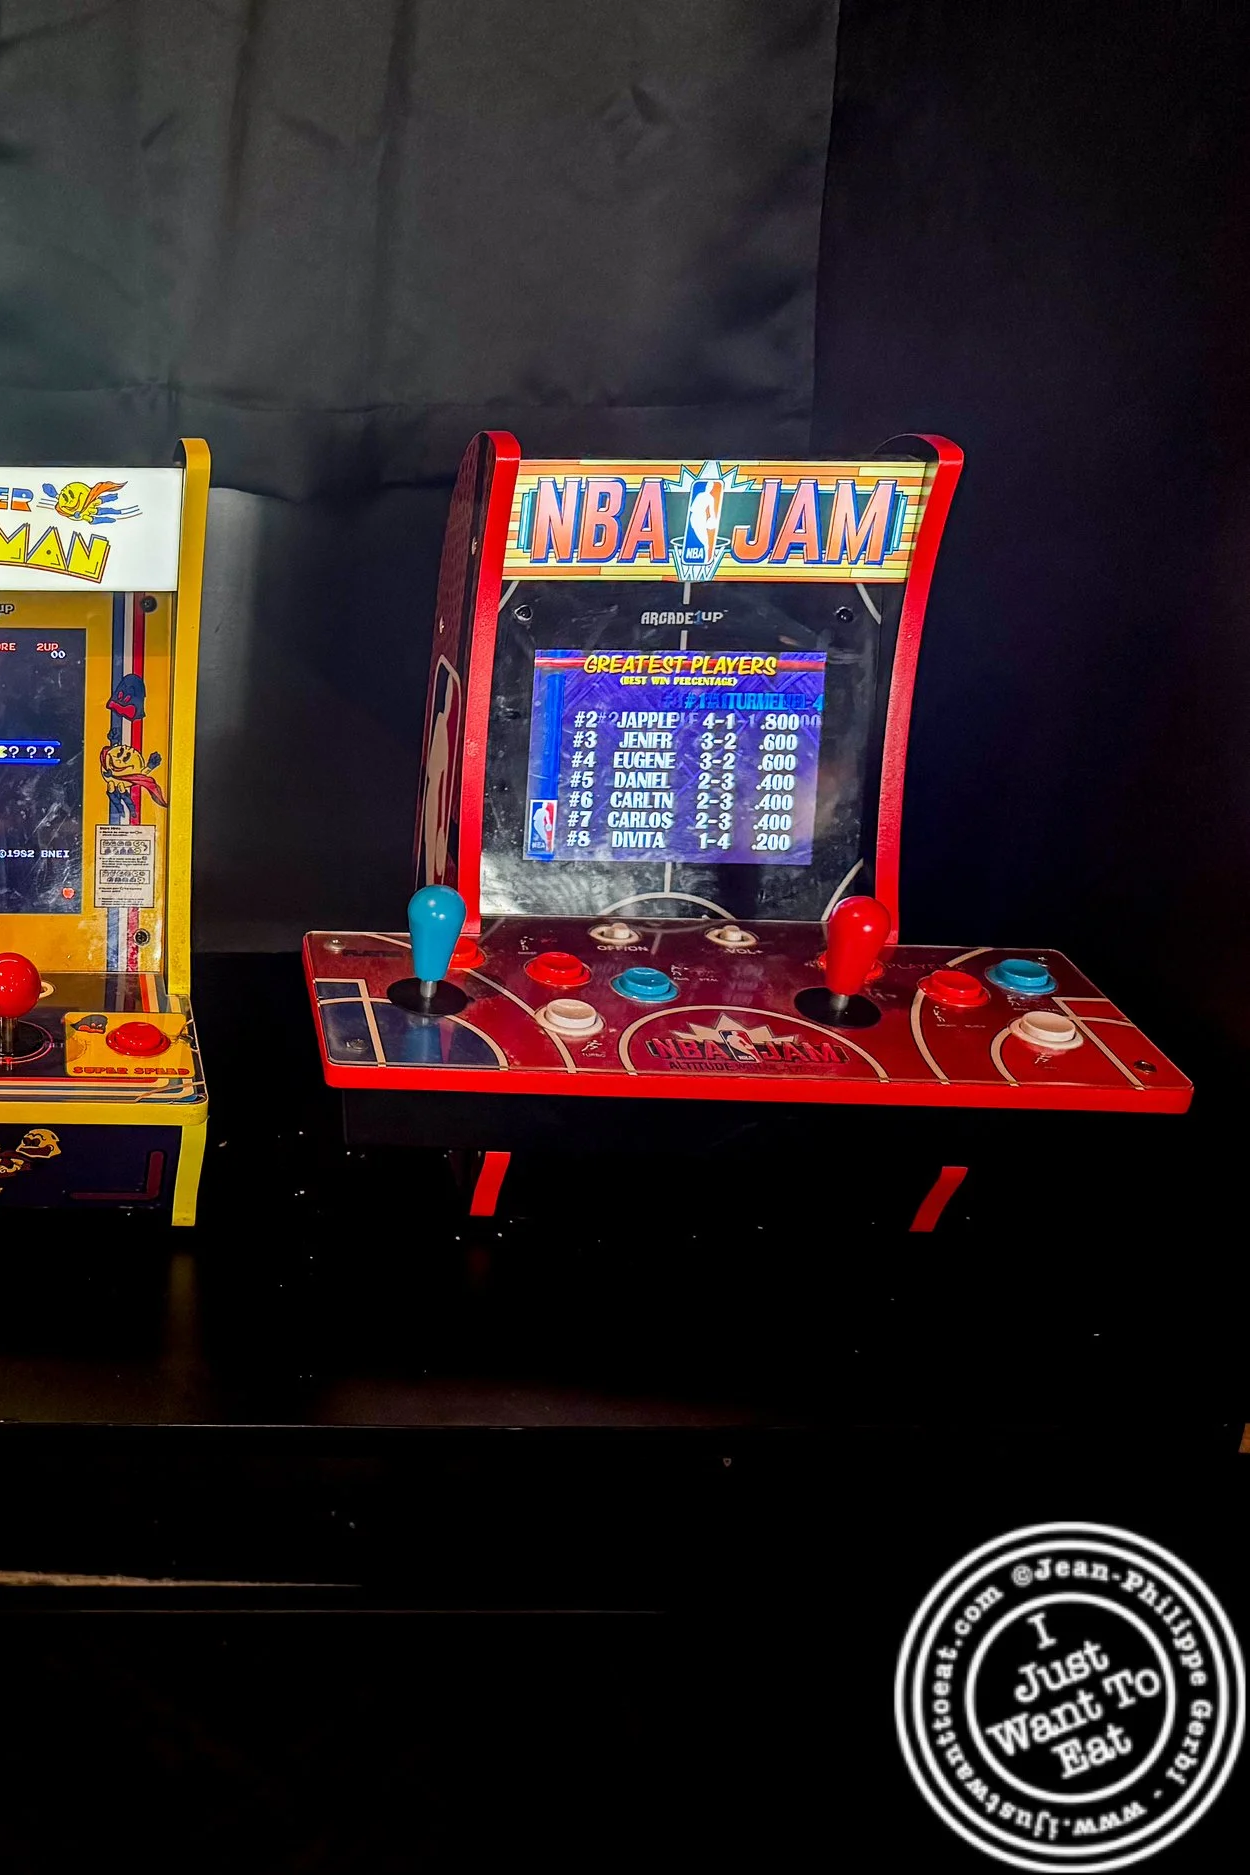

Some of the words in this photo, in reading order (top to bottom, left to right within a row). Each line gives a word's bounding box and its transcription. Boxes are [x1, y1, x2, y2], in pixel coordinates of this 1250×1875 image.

[529, 476, 671, 565] NBA
[729, 477, 898, 566] JAM
[685, 547, 705, 560] NBA
[36, 643, 59, 652] 2UP
[583, 654, 684, 674] GREATEST
[690, 655, 778, 676] PLAYERS
[651, 676, 670, 686] WIN
[574, 711, 598, 728] #2
[616, 711, 678, 729] JAPPLE
[702, 713, 736, 730] 4-1
[760, 713, 799, 731] .800
[573, 731, 597, 747] #3
[619, 732, 673, 749] JENIFR
[701, 732, 737, 750] 3-2
[759, 733, 798, 751] .600
[571, 751, 596, 768] #4
[613, 751, 676, 769] EUGENE
[700, 753, 735, 770] 3-2
[757, 753, 796, 771] .600
[570, 771, 594, 788] #5
[614, 772, 671, 789] DANIEL
[697, 773, 735, 790] 2-3
[756, 773, 795, 791] .400
[568, 791, 593, 808] #6
[610, 791, 674, 809] CARLTN
[696, 793, 734, 810] 2-3
[754, 793, 793, 811] .400
[567, 811, 593, 828] #7
[607, 811, 674, 829] CARLOS
[695, 813, 732, 830] 2-3
[753, 813, 792, 831] .400
[566, 830, 590, 847] #8
[611, 831, 666, 849] DIVITA
[699, 833, 731, 850] 1-4
[751, 833, 790, 851] .200
[650, 1037, 730, 1060] NBA
[760, 1040, 842, 1063] JAM
[73, 1066, 128, 1075] SUPER
[134, 1067, 190, 1076] SPEED
